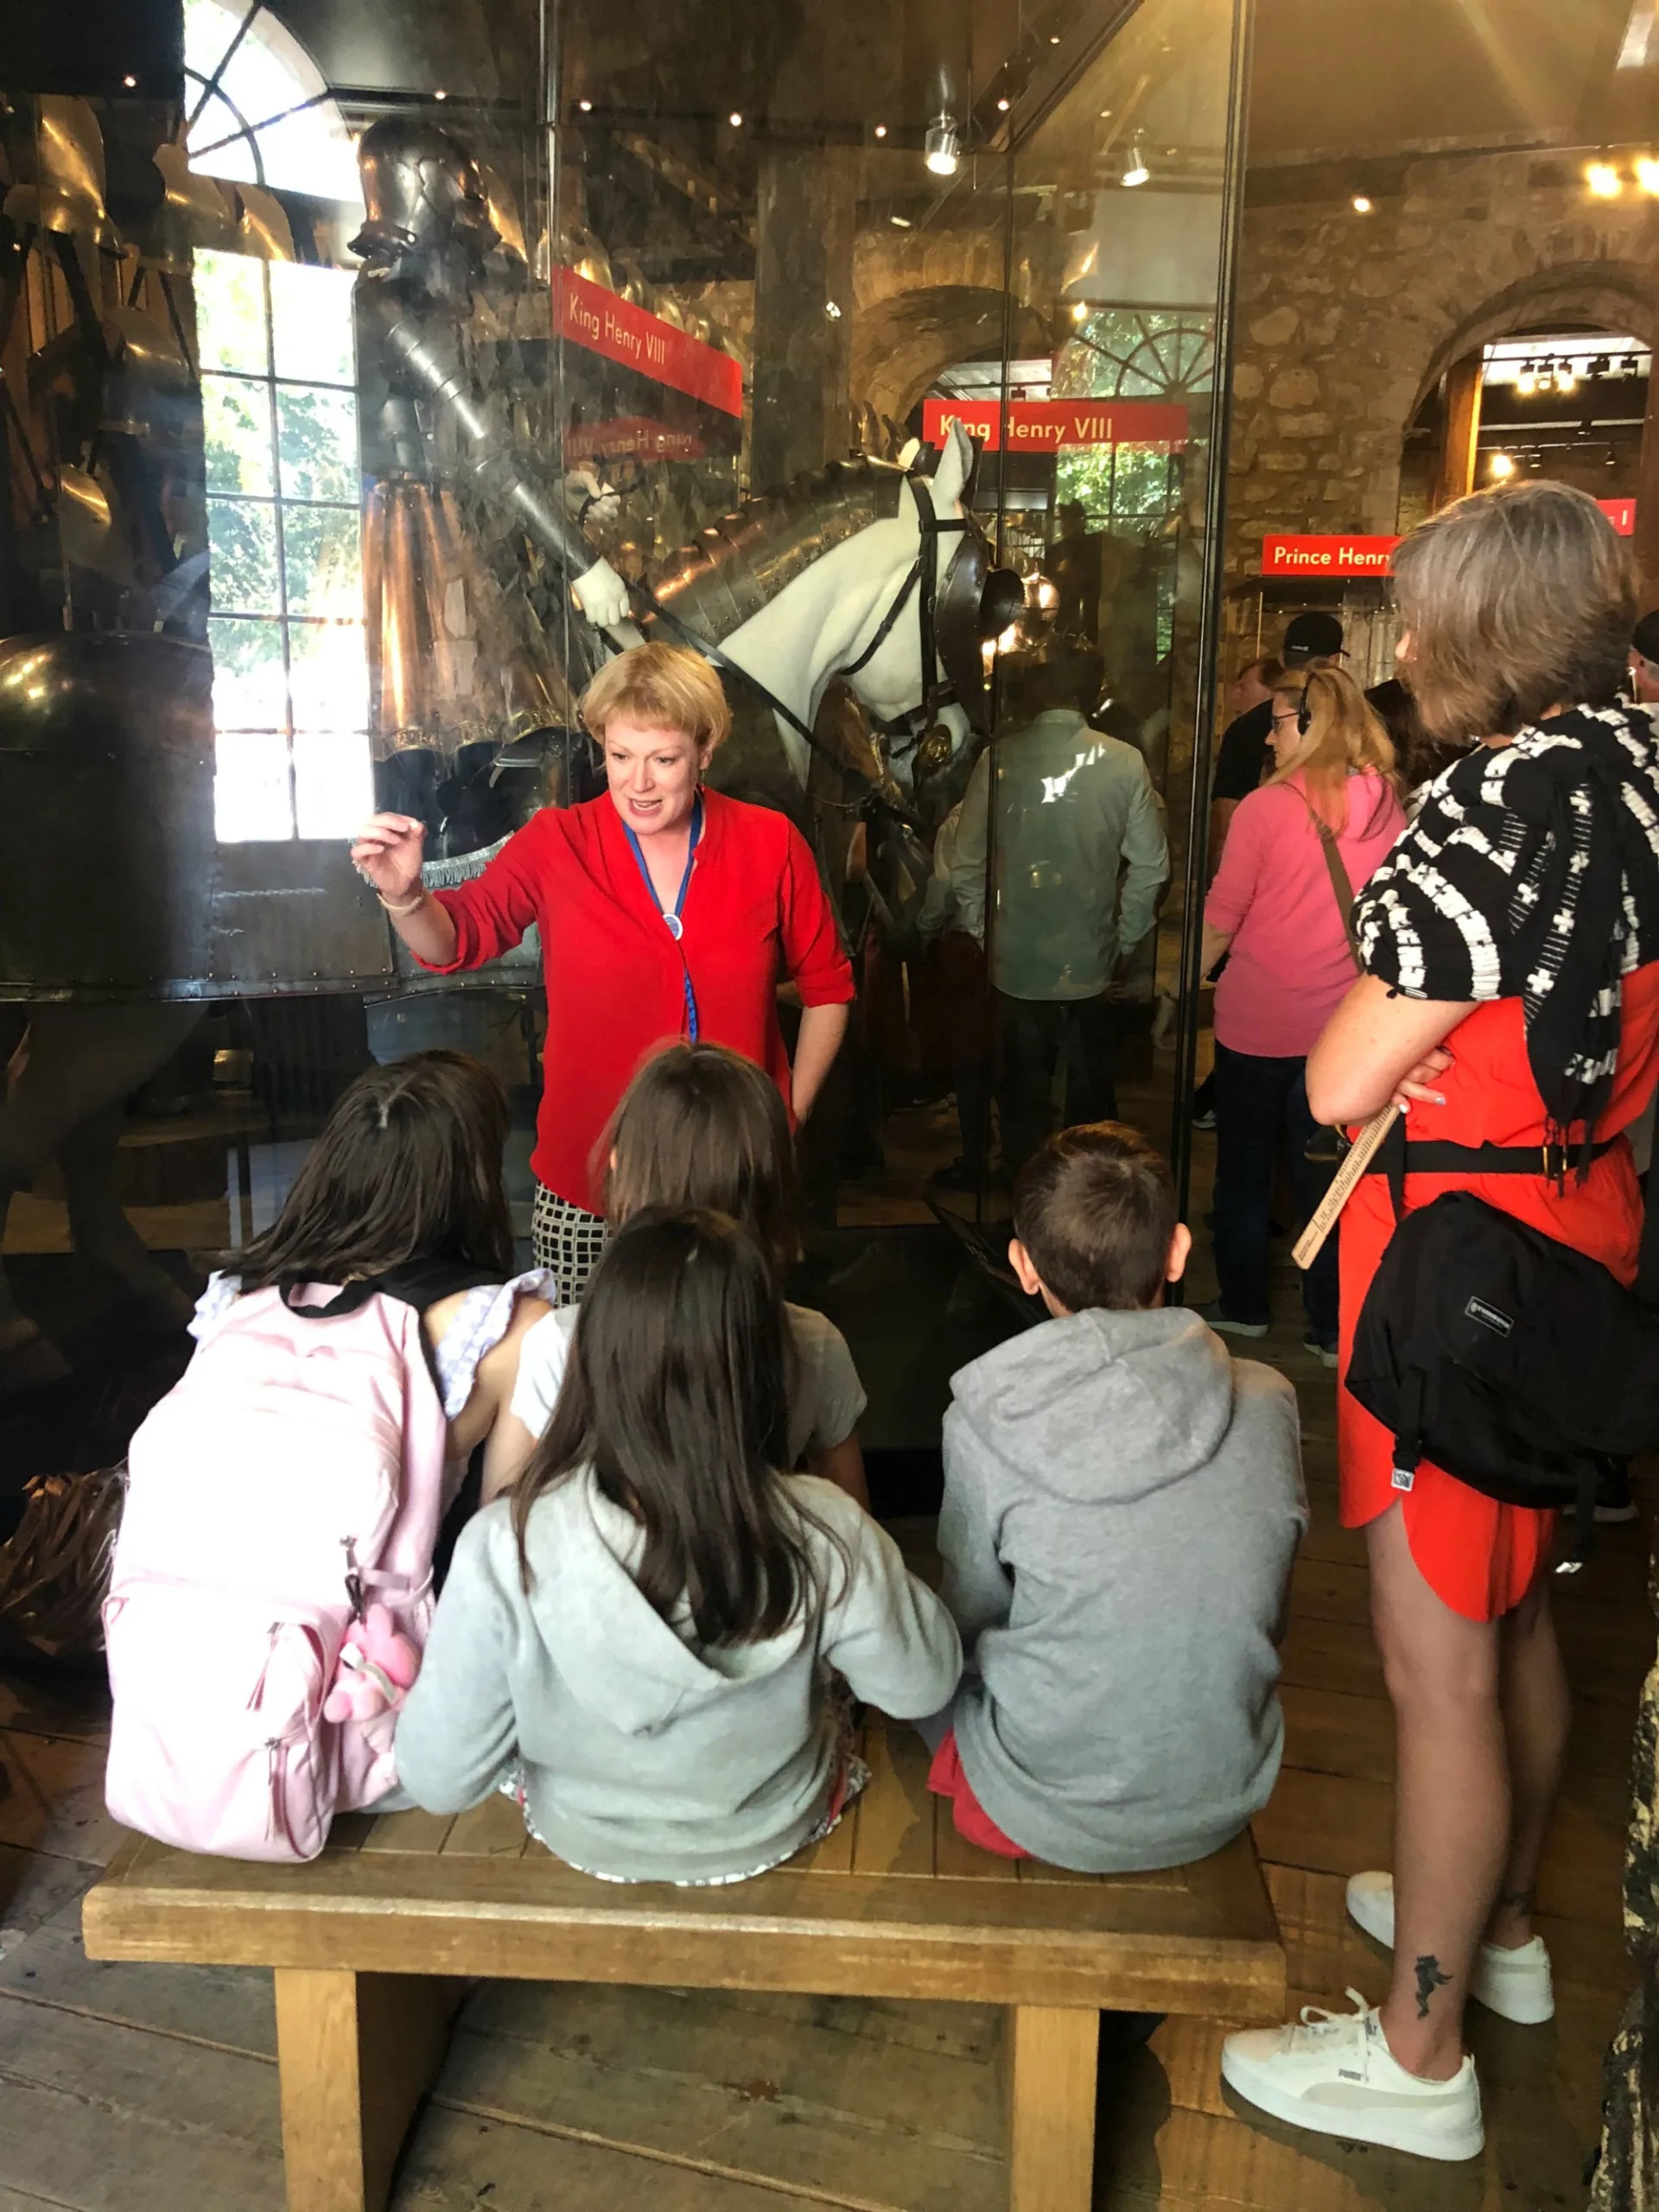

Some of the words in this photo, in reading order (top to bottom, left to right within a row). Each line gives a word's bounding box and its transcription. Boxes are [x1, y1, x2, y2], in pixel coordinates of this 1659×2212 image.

[569, 292, 600, 340] King
[605, 310, 642, 359] Henry
[645, 331, 665, 365] VIII
[939, 414, 991, 443] Kng
[1074, 417, 1113, 440] VIII
[1274, 545, 1332, 565] Prince
